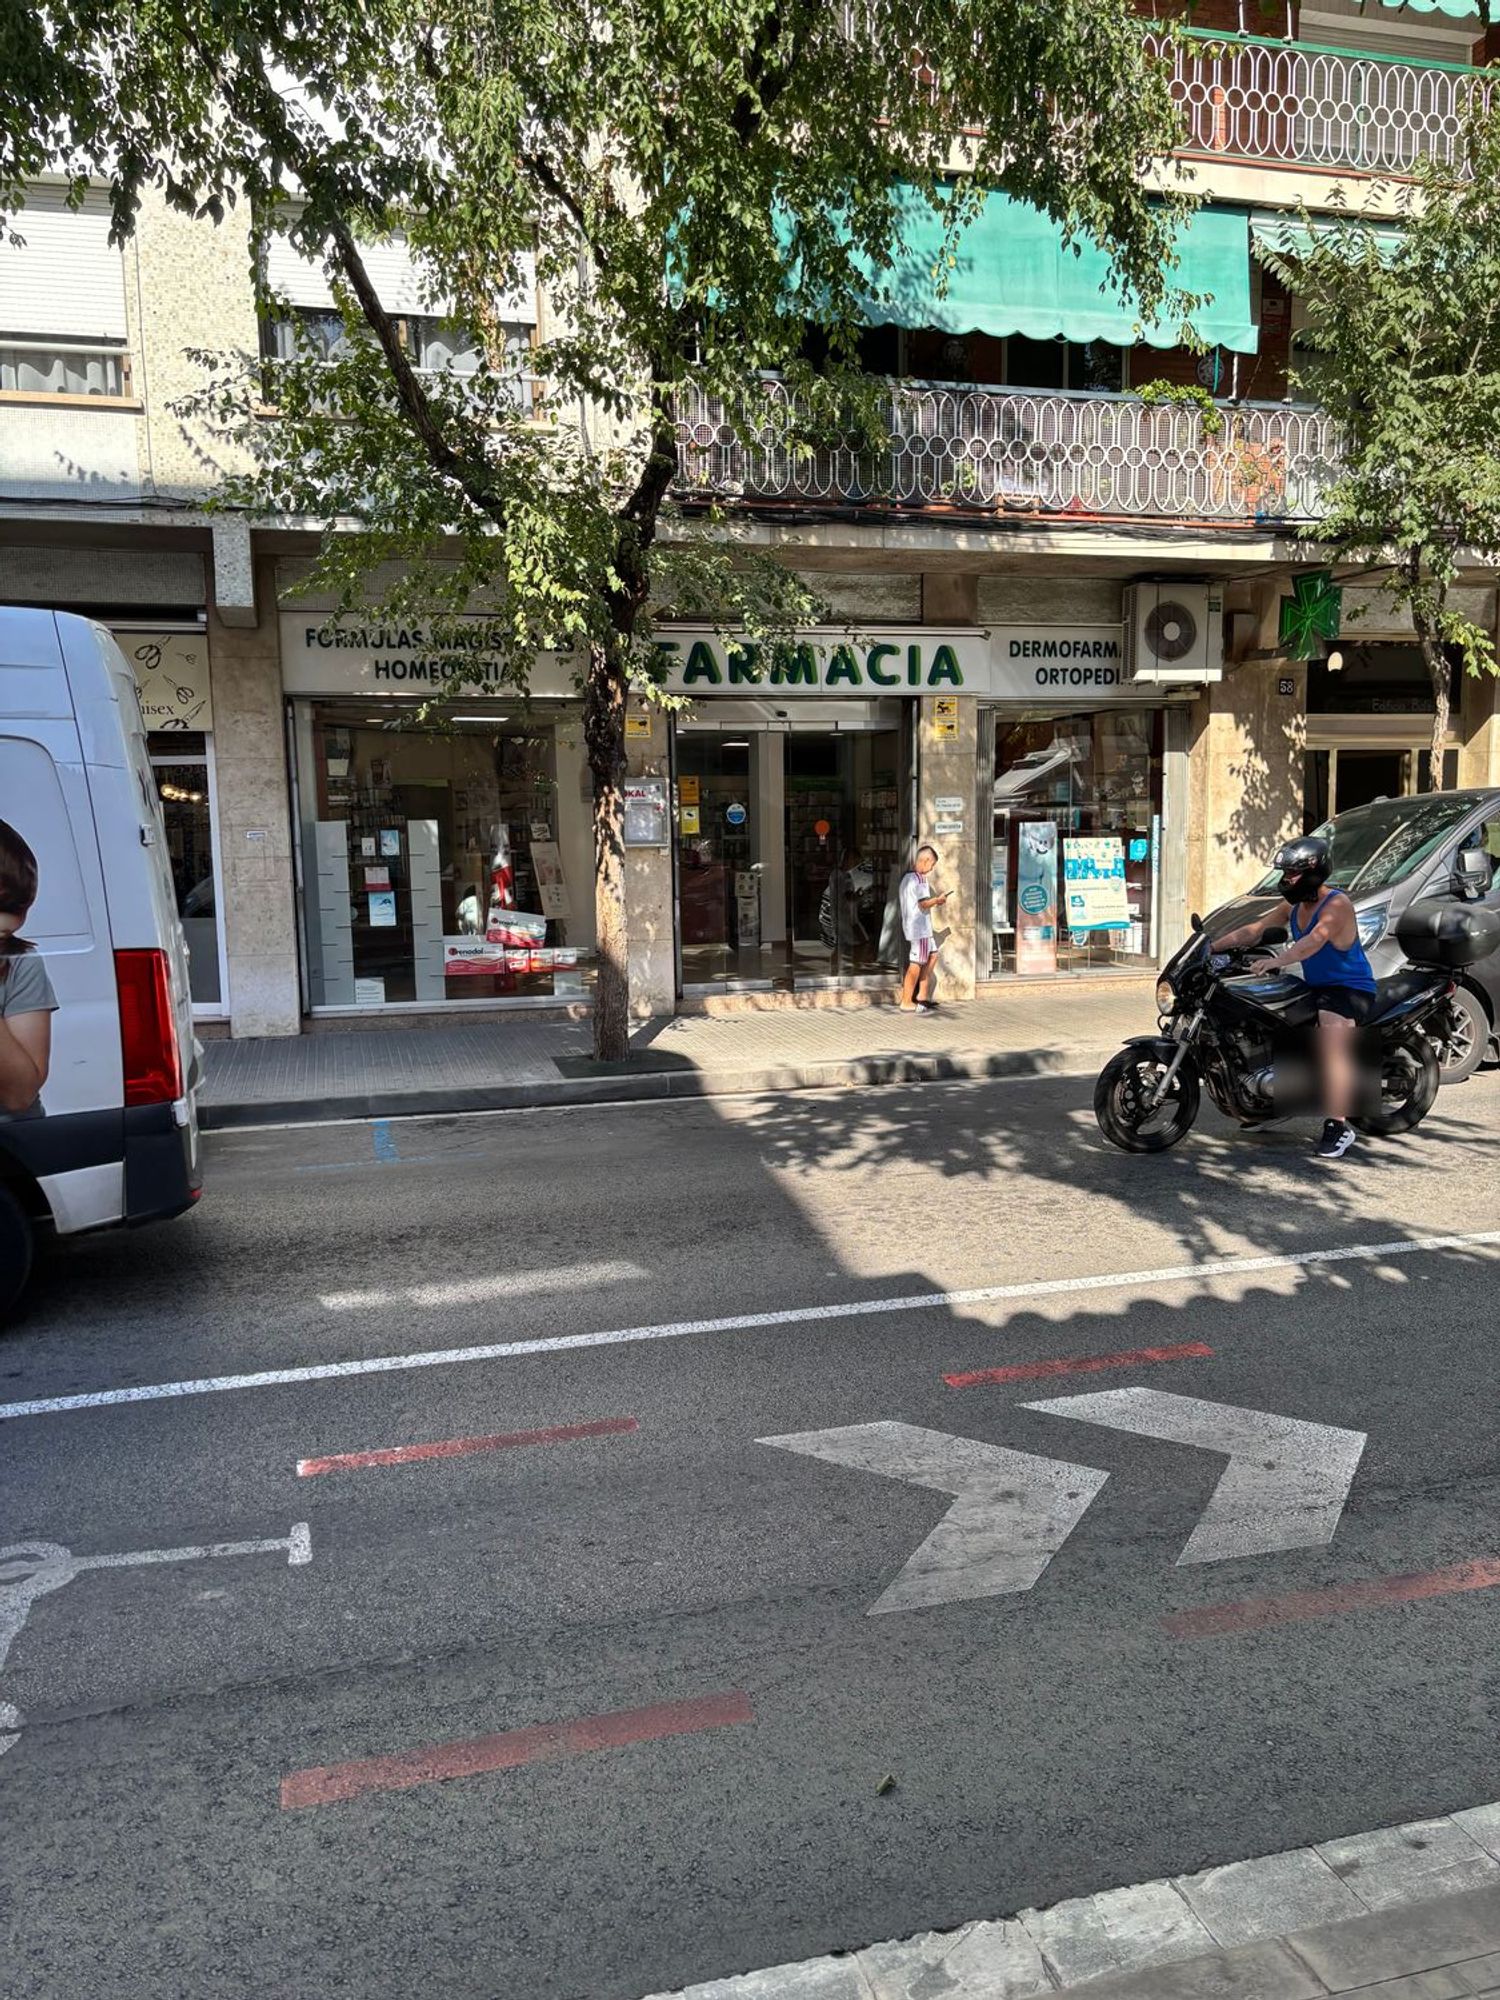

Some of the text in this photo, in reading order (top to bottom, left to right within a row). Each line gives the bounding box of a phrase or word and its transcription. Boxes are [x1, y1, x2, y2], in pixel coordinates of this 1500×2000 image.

[1009, 640, 1122, 658] DERMOFARM
[374, 659, 512, 681] HOMEOTIA
[650, 641, 964, 687] FARMACIA
[1035, 667, 1123, 685] ORTOPEDI
[1280, 680, 1294, 693] 58
